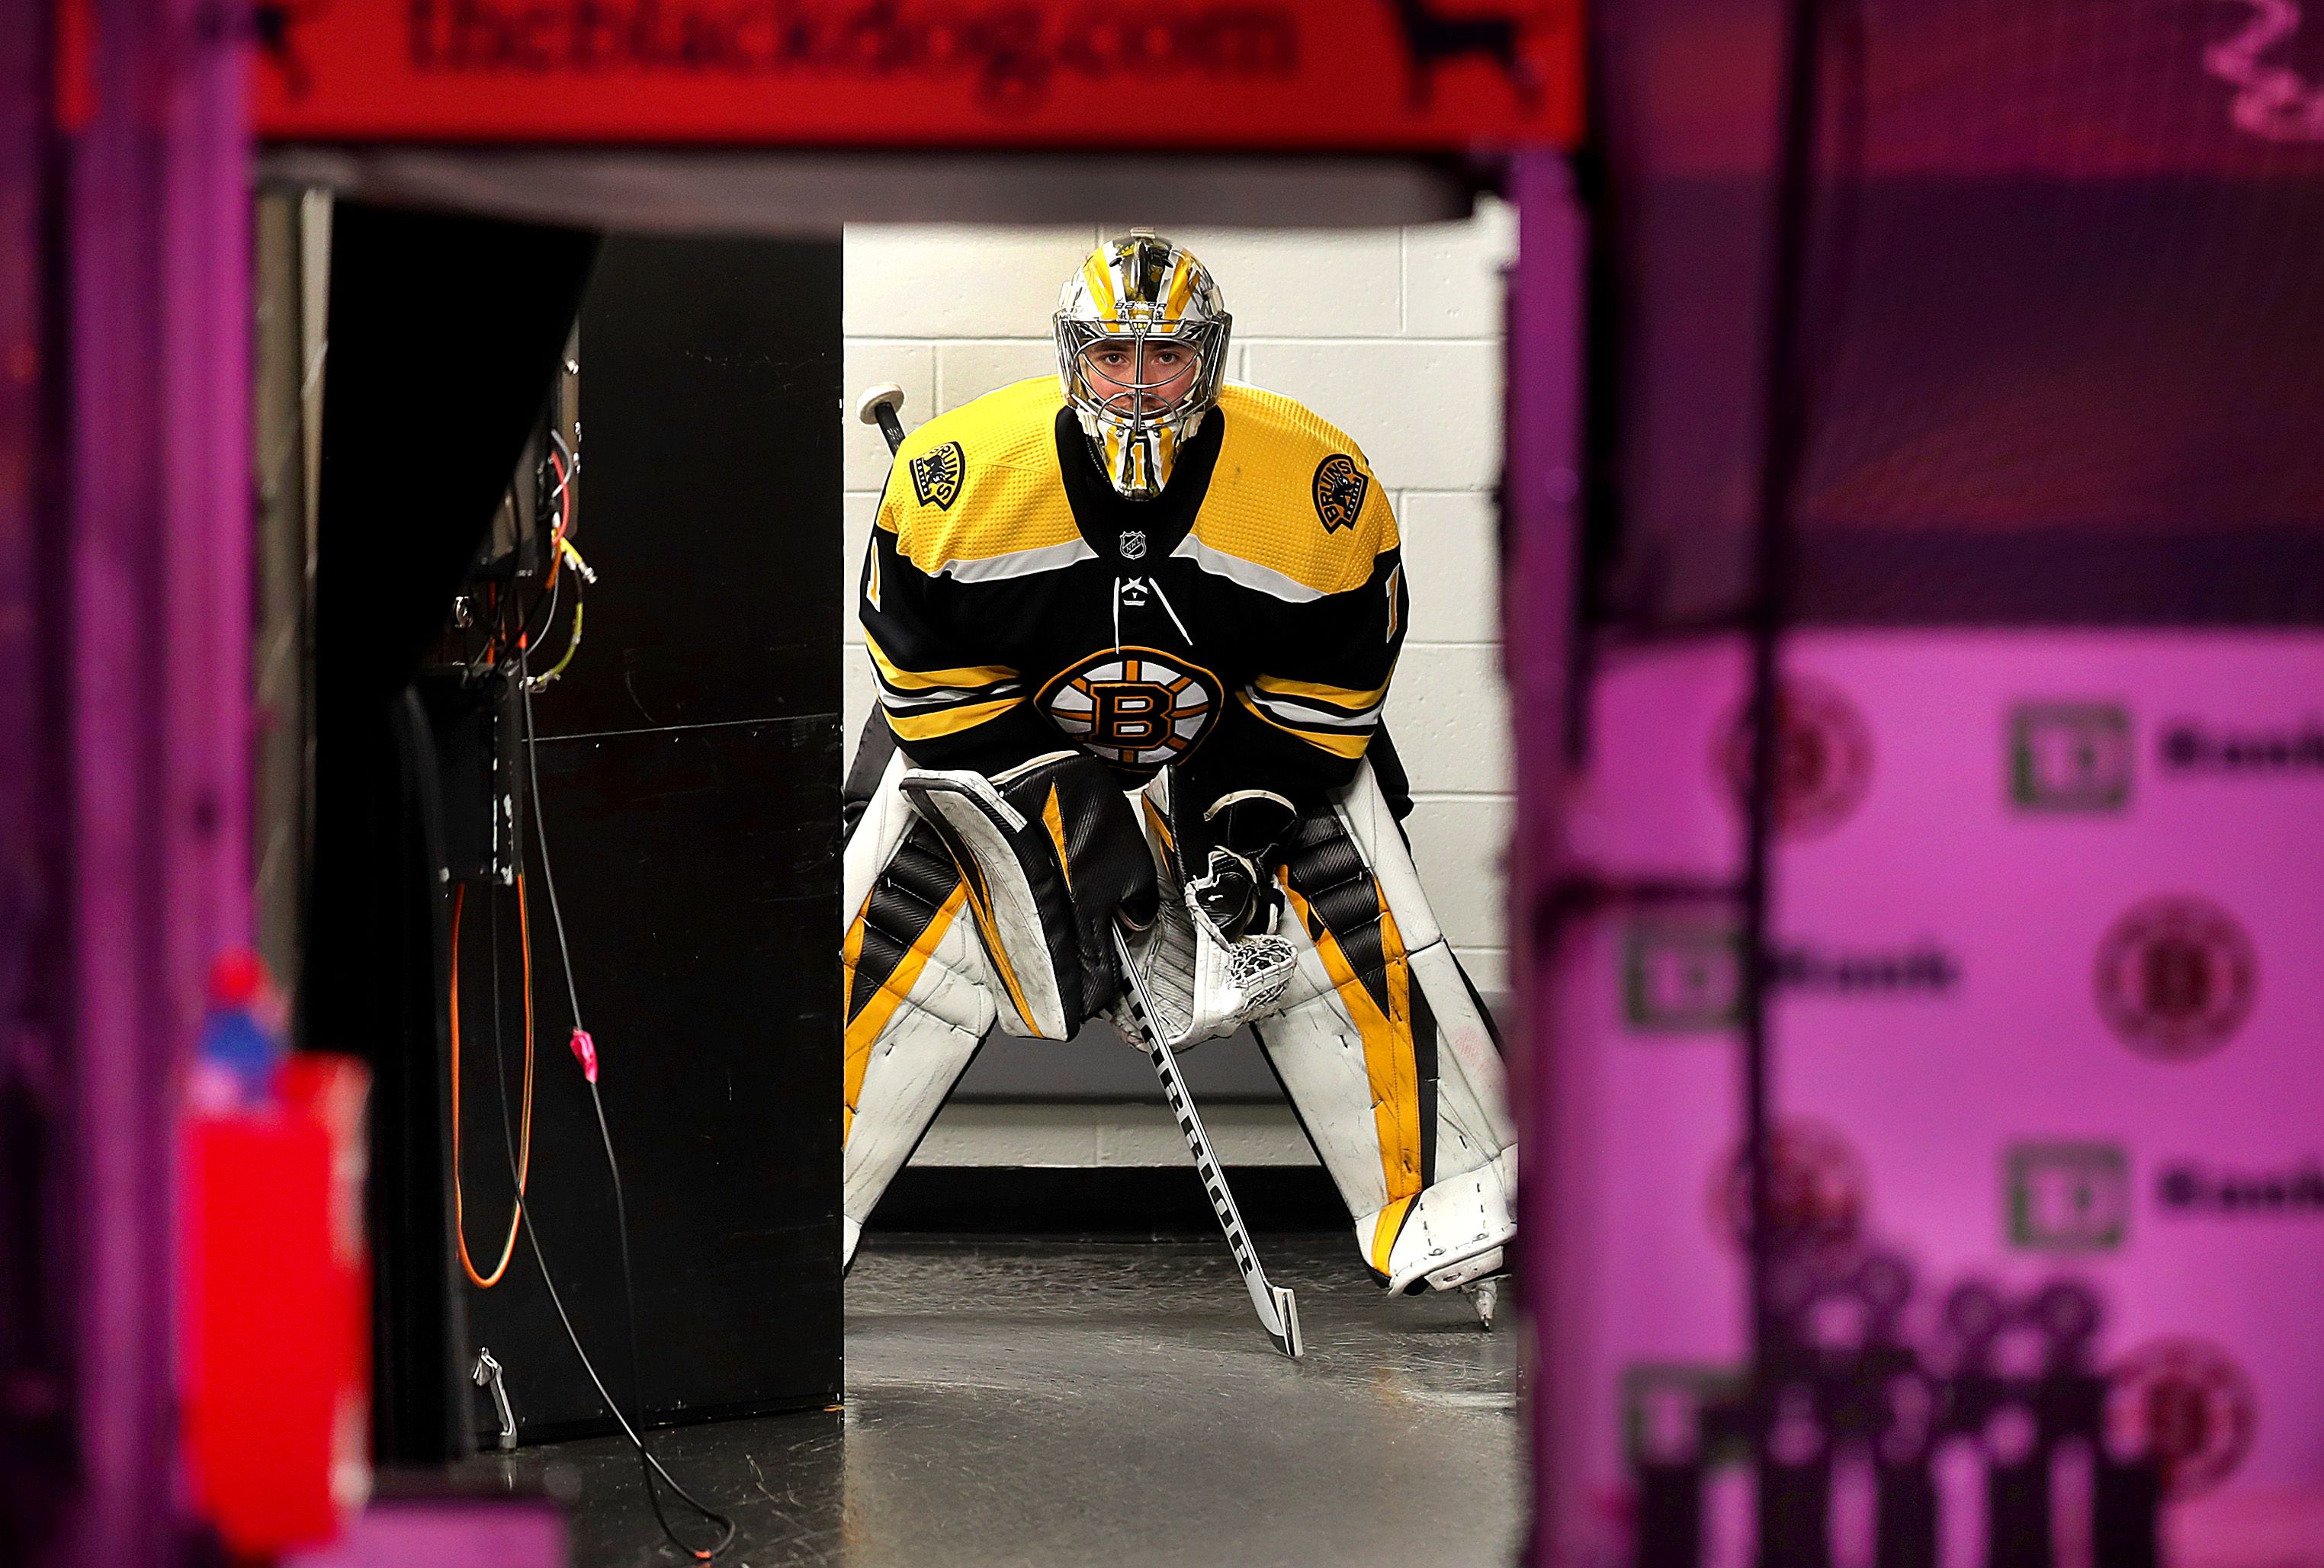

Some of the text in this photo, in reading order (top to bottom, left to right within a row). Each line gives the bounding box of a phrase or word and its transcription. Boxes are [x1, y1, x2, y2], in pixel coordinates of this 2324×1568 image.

[1130, 442, 1147, 489] 1
[1319, 460, 1353, 522] BRUINS
[1126, 538, 1141, 553] NHL
[1090, 682, 1173, 749] B
